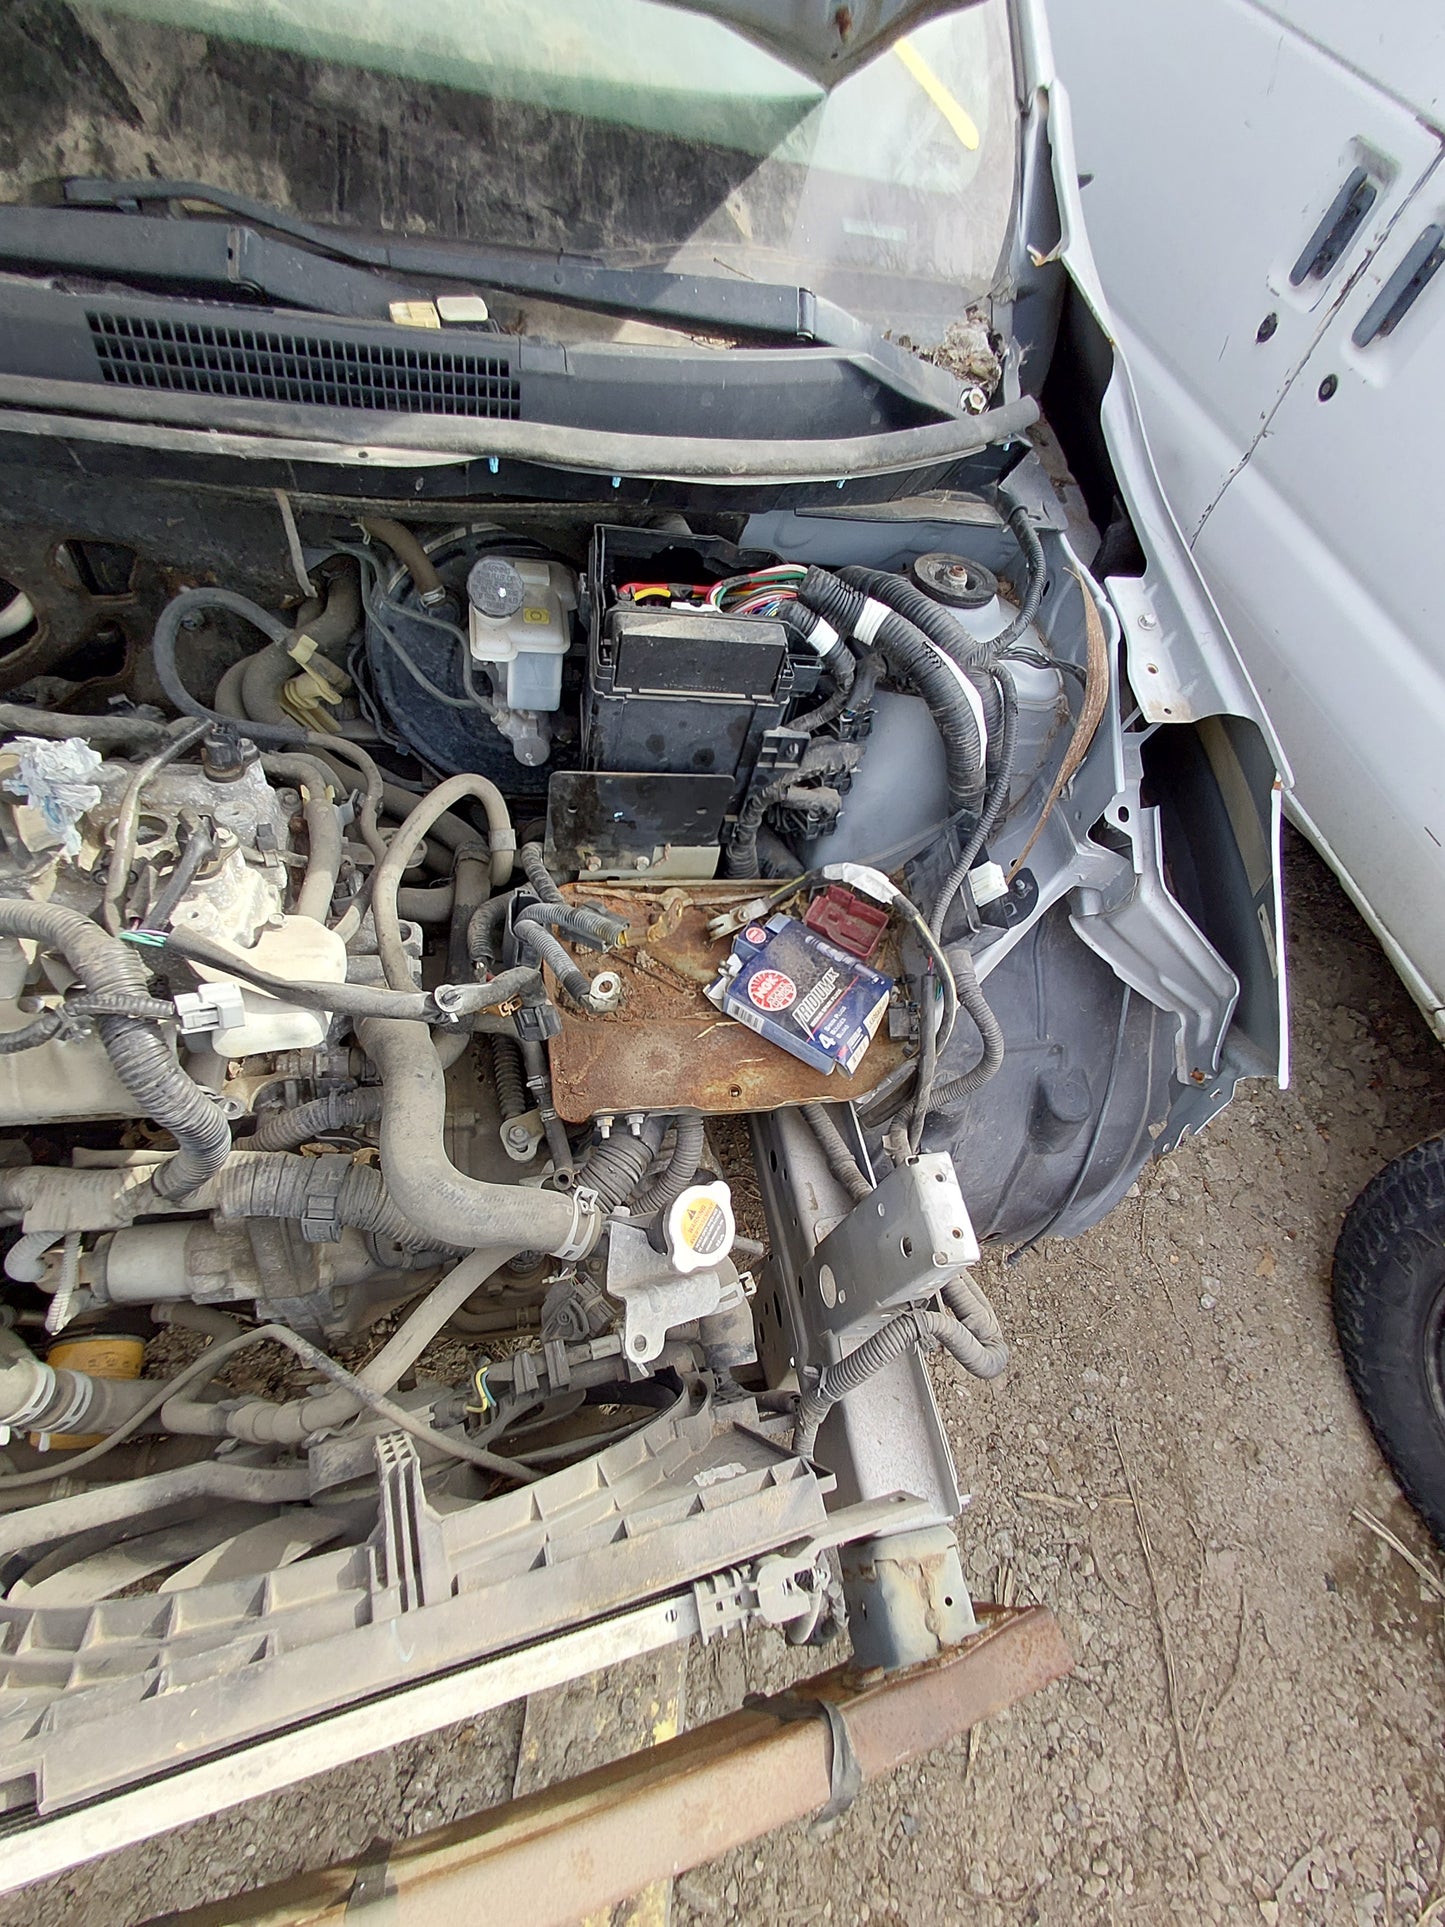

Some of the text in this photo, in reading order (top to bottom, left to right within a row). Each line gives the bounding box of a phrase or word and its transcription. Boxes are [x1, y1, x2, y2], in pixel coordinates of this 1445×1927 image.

[754, 974, 779, 999] NGK
[819, 1033, 836, 1049] 4
[688, 1204, 706, 1233] WARNING
